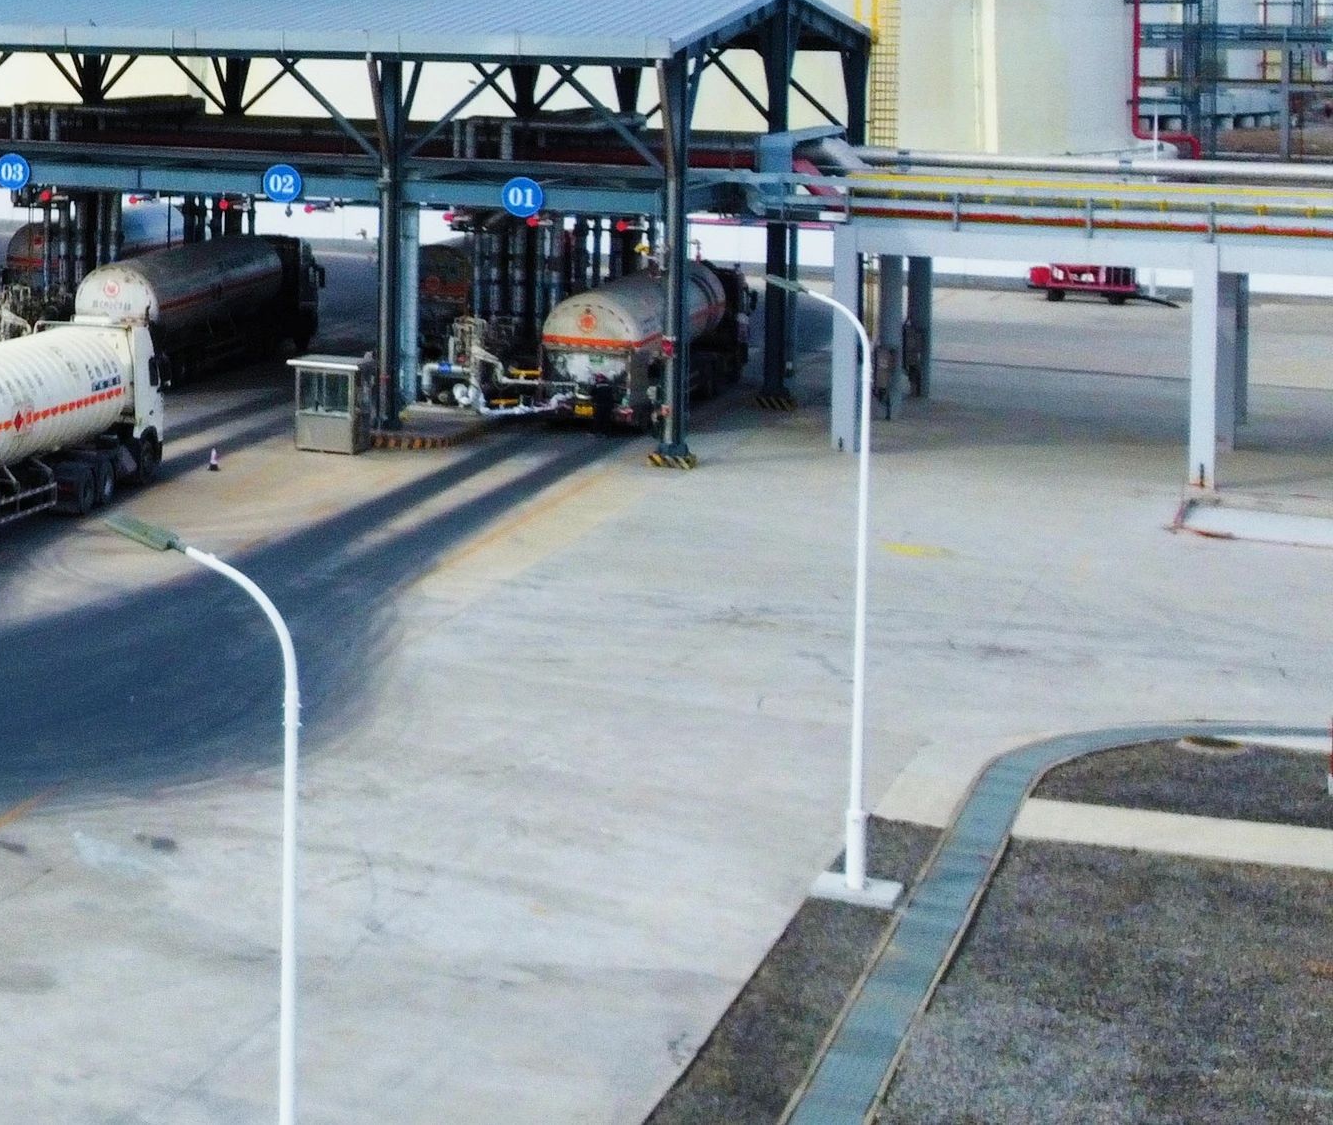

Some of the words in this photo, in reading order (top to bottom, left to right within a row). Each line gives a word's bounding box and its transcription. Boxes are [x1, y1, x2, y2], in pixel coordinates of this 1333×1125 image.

[1, 163, 23, 181] 03
[269, 175, 295, 194] 02
[509, 188, 535, 207] 01
